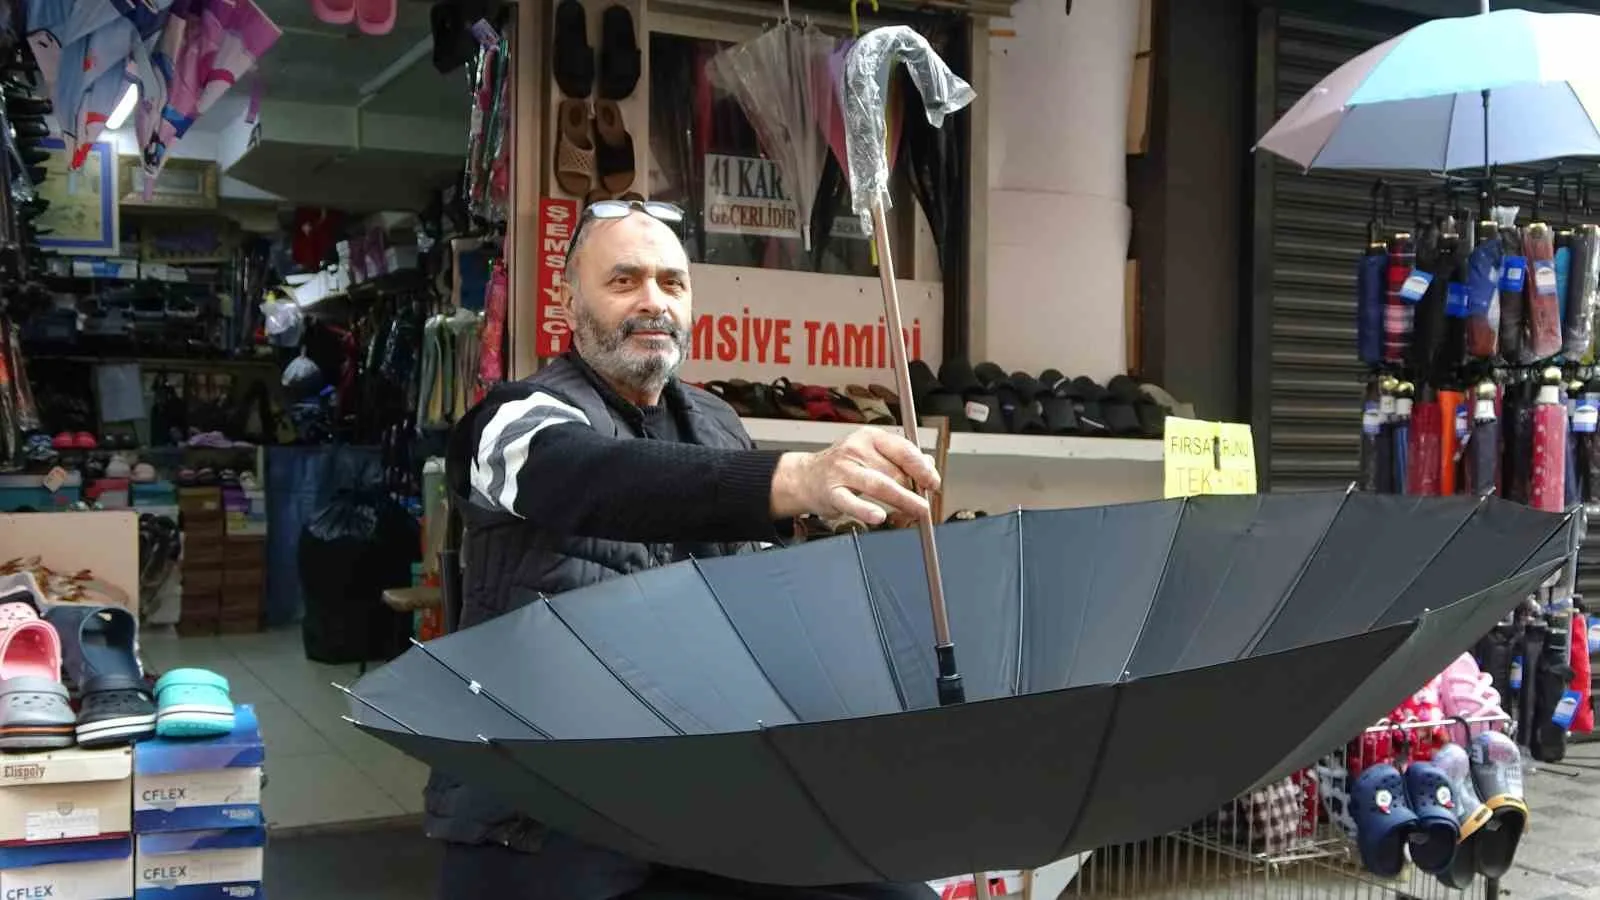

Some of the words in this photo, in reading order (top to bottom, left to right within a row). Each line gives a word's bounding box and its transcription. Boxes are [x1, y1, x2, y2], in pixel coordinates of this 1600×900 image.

[709, 157, 730, 195] 41
[736, 158, 791, 201] KAR
[709, 203, 797, 230] GEÇERLİDİR
[691, 307, 792, 364] MSİYE
[1175, 467, 1213, 493] TEK
[142, 788, 187, 802] CFLEX
[143, 865, 188, 881] CFLEX
[6, 885, 54, 900] CFLEX
